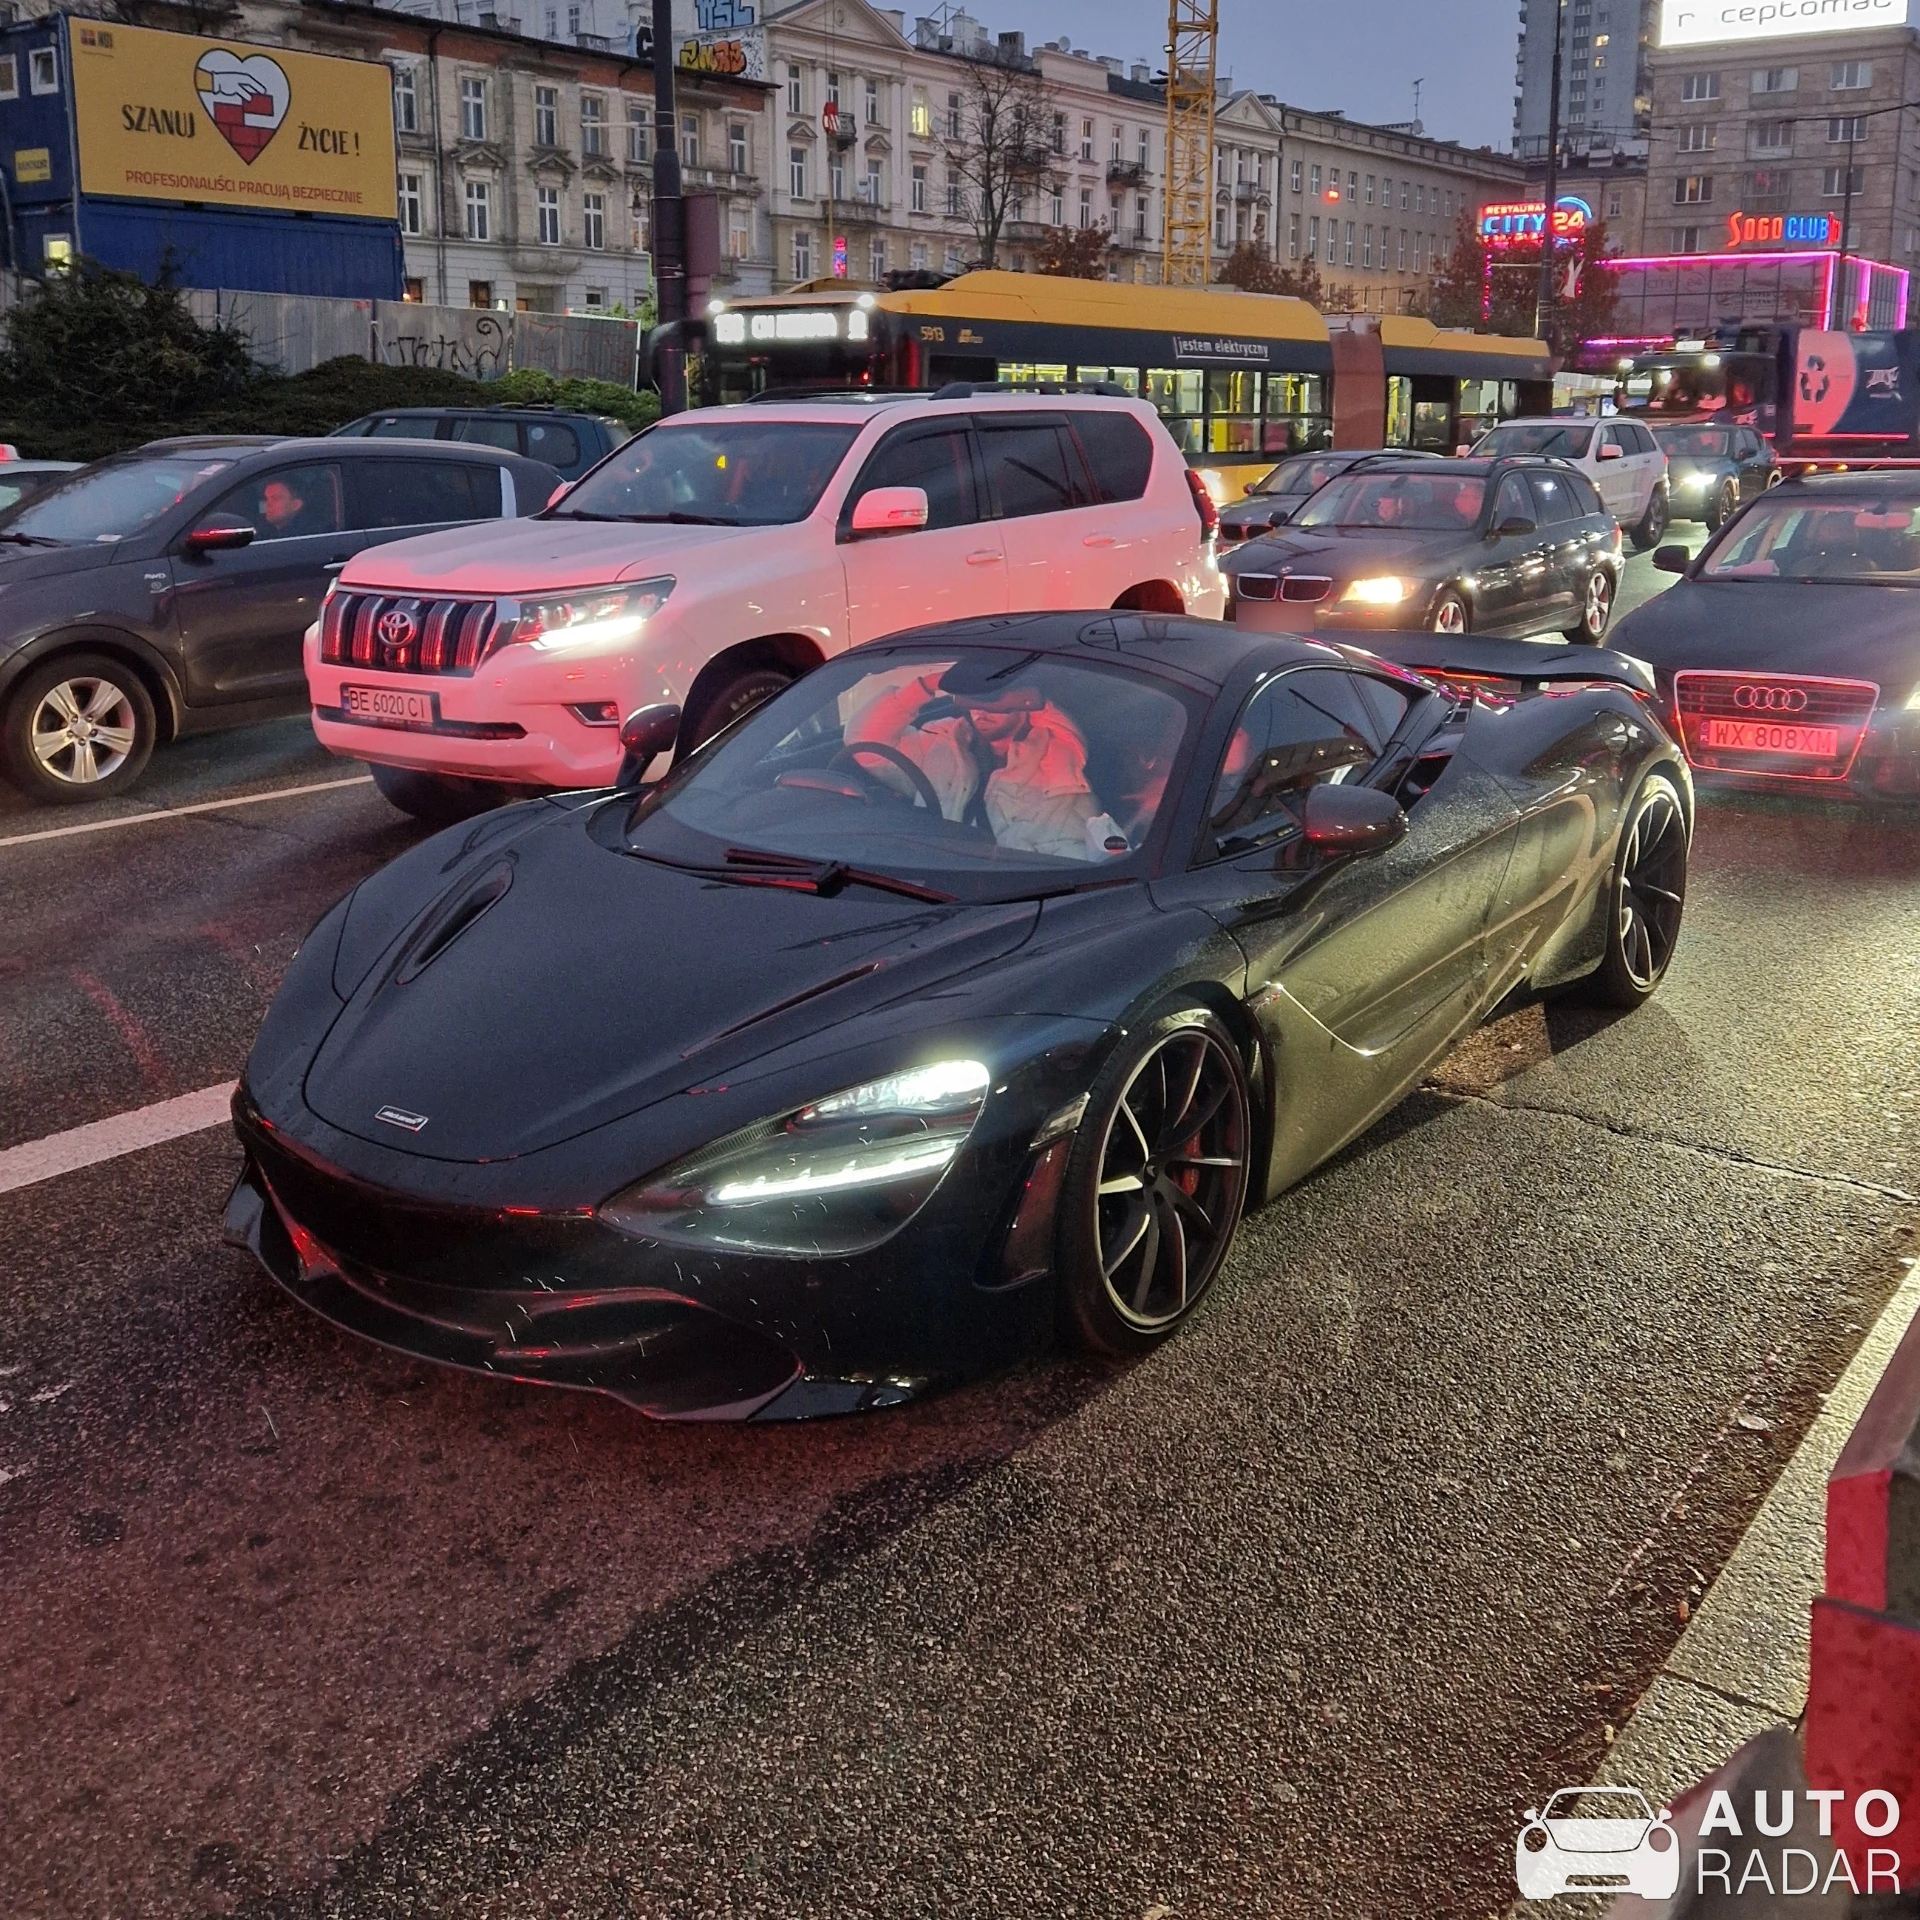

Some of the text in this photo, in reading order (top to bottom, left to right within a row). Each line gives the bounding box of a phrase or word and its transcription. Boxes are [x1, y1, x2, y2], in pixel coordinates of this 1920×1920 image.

[122, 104, 195, 138] SZANUJ
[125, 169, 364, 204] PROFESJONALIŚCI PRACUJĄ BEZPIECZNIE
[1484, 211, 1585, 233] CITY 24
[1177, 336, 1268, 358] jestem elektryczny
[350, 690, 425, 718] BE 6020 CI
[1715, 723, 1832, 753] WX 808XM
